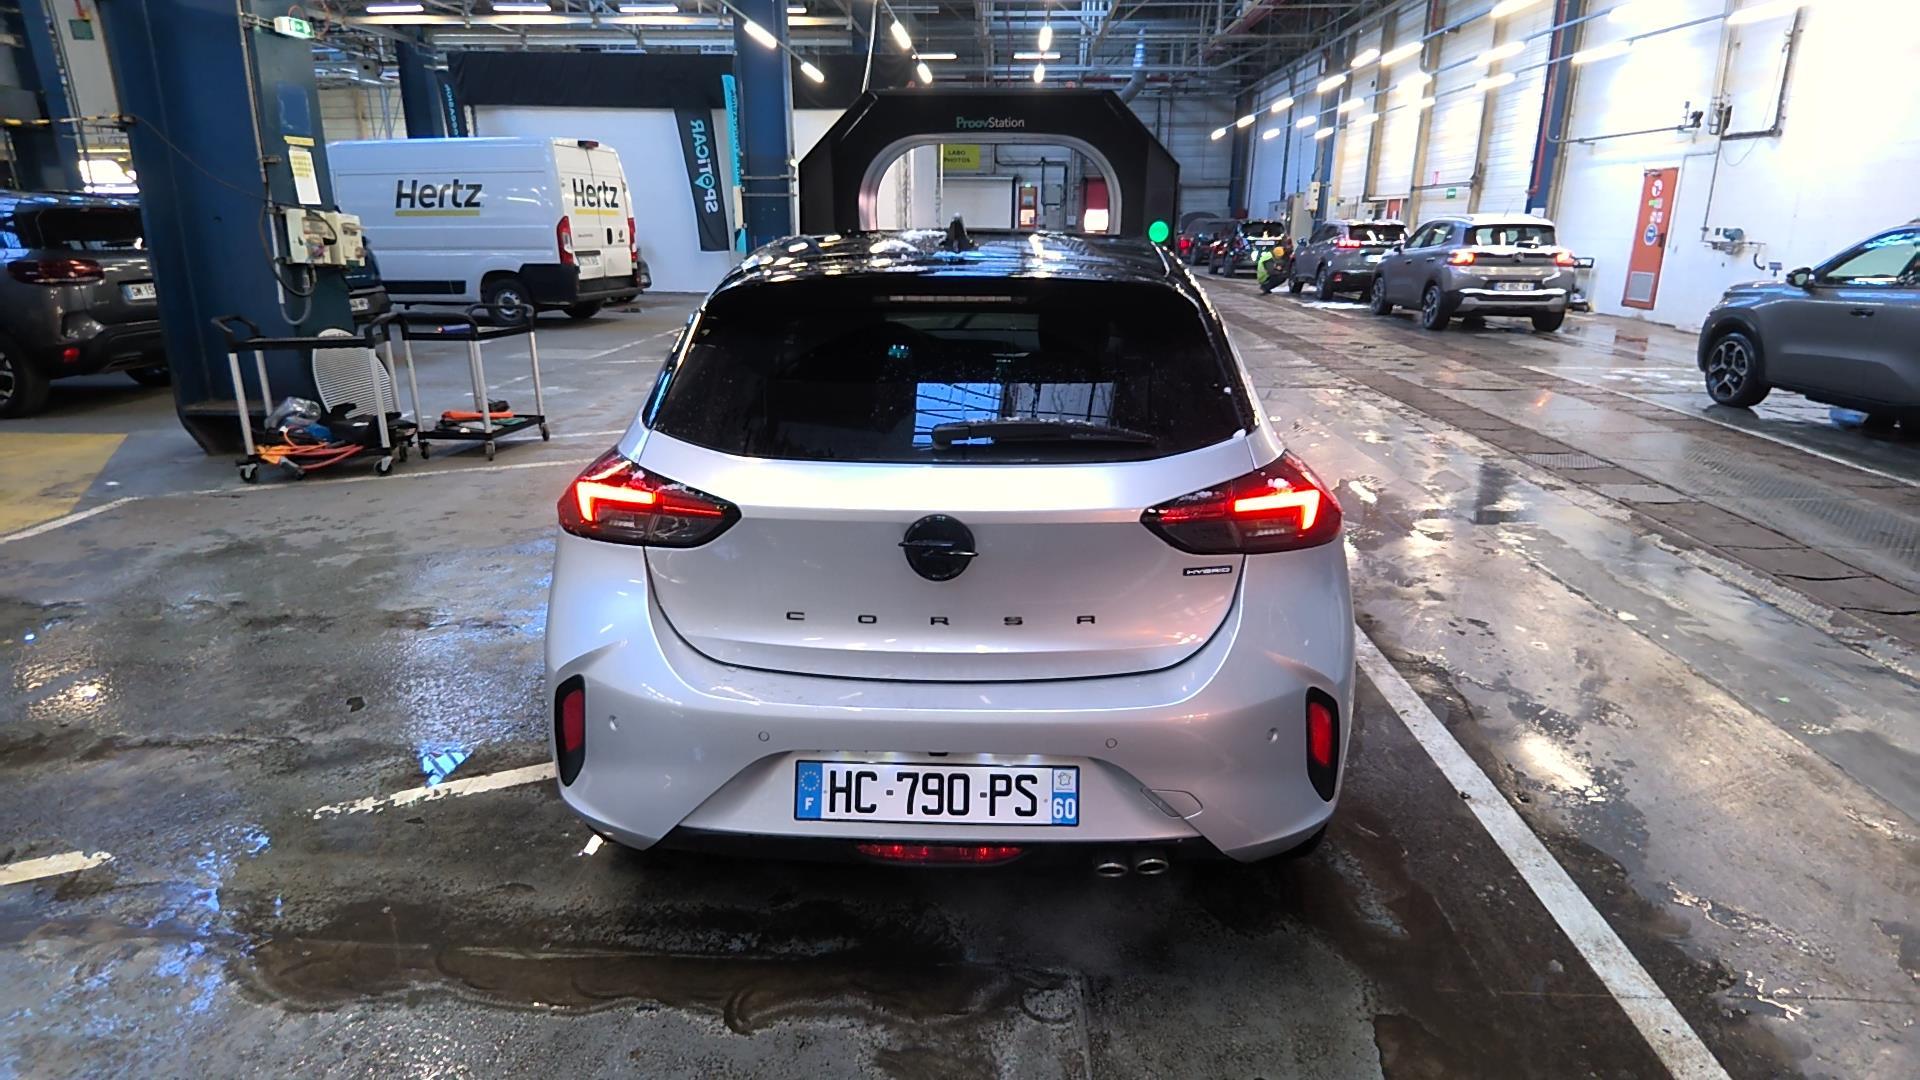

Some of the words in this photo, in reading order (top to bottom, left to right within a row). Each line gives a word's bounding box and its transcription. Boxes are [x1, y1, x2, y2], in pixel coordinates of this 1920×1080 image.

[955, 116, 1025, 129] ProovStation
[395, 179, 483, 209] Hertz
[572, 178, 619, 209] Hertz
[1186, 567, 1231, 575] HYBRID
[786, 610, 1097, 626] CORSA
[804, 797, 814, 811] F
[1052, 797, 1077, 820] 60
